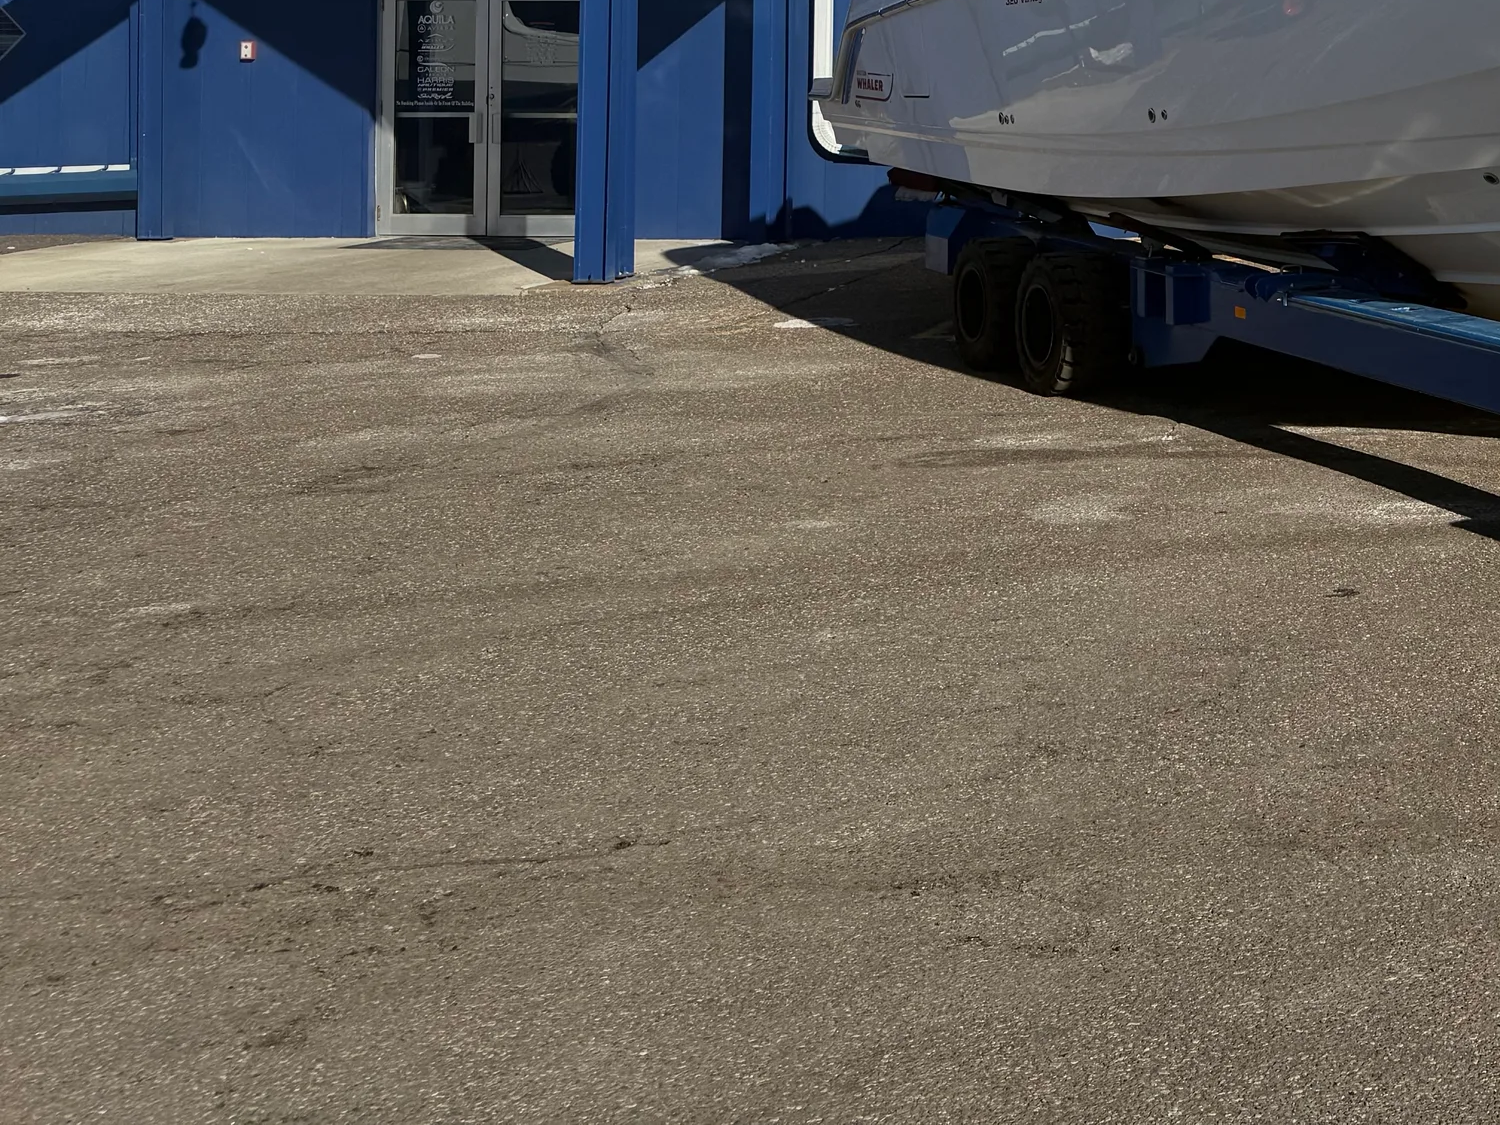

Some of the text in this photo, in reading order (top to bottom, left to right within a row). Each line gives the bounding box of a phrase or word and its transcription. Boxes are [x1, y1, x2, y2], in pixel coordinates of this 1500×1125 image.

[417, 14, 455, 24] AQUILA
[417, 76, 455, 84] HARRIS
[856, 78, 884, 92] WHALER
